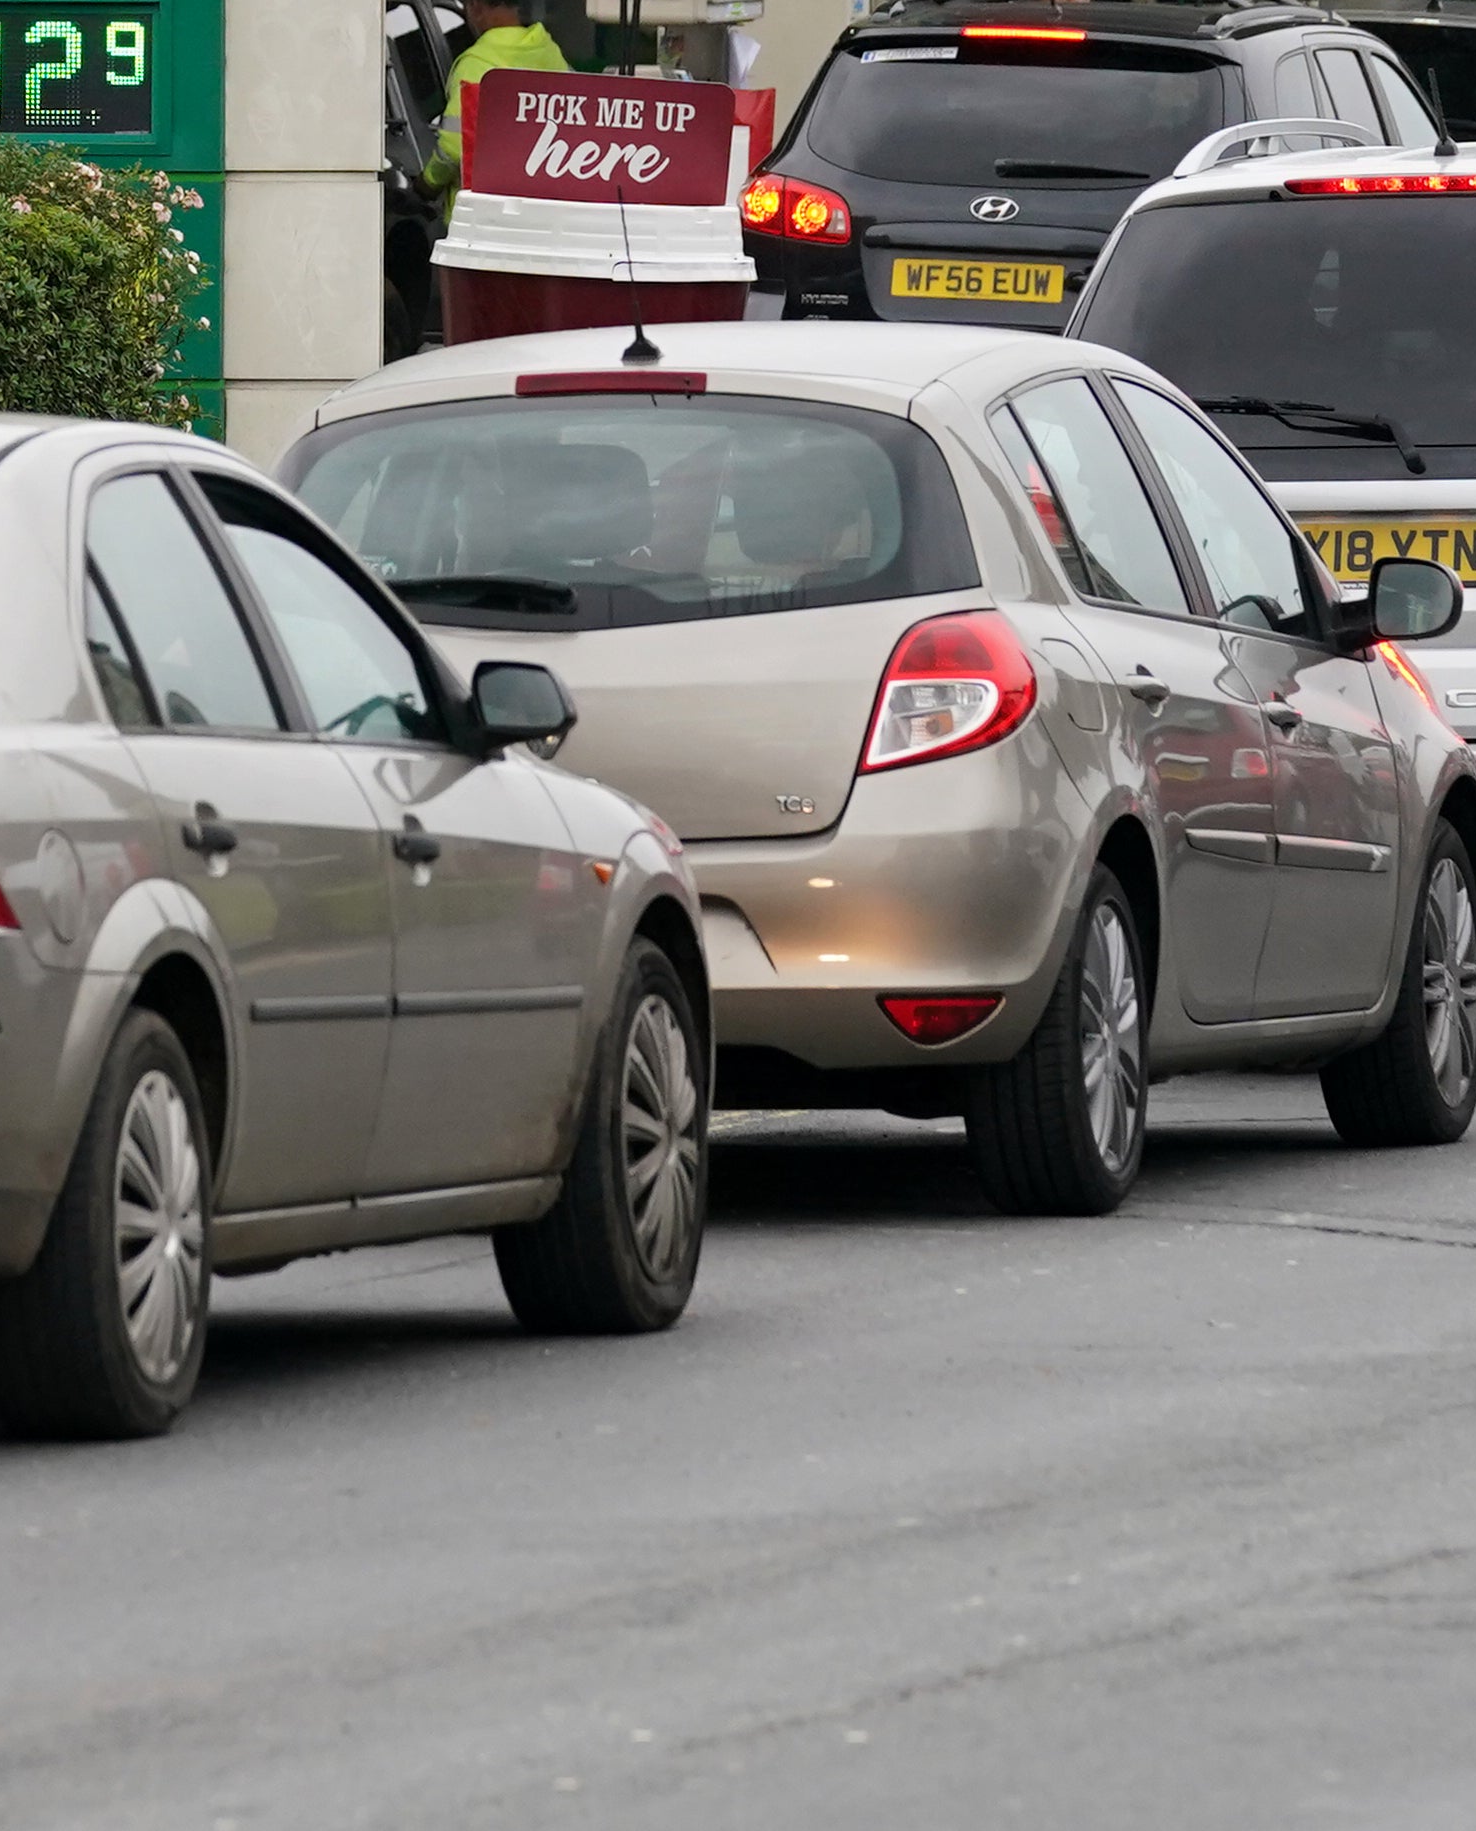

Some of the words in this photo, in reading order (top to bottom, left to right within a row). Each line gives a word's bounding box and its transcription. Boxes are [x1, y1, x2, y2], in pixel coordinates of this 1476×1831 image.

[515, 91, 588, 127] PICK
[595, 96, 646, 130] ME
[654, 100, 697, 134] UP
[524, 119, 671, 184] here
[906, 263, 983, 294] WF56
[991, 268, 1052, 297] EUW
